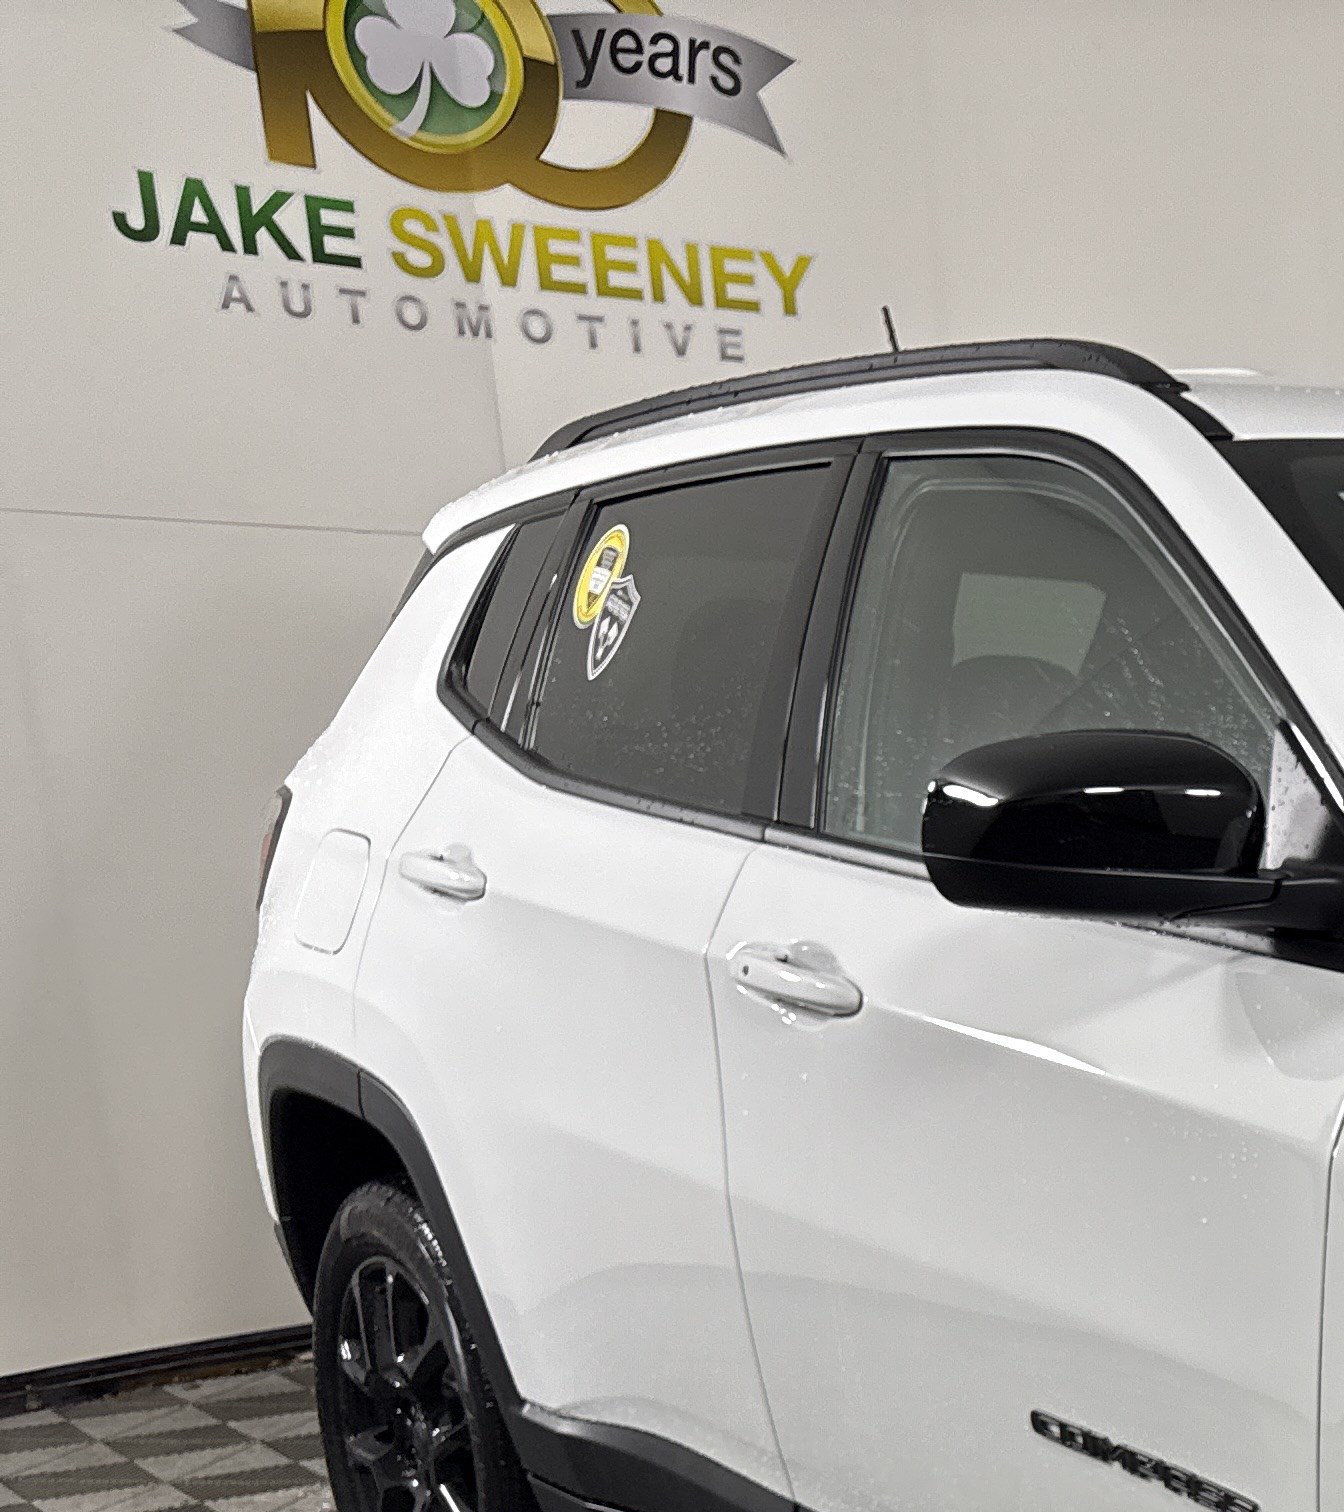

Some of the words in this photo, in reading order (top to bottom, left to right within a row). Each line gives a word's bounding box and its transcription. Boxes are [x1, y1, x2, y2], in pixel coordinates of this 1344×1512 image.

[570, 26, 743, 97] years
[112, 169, 364, 269] JAKE
[389, 207, 814, 317] SWEENEY
[219, 274, 746, 363] AUTOMOTIVE
